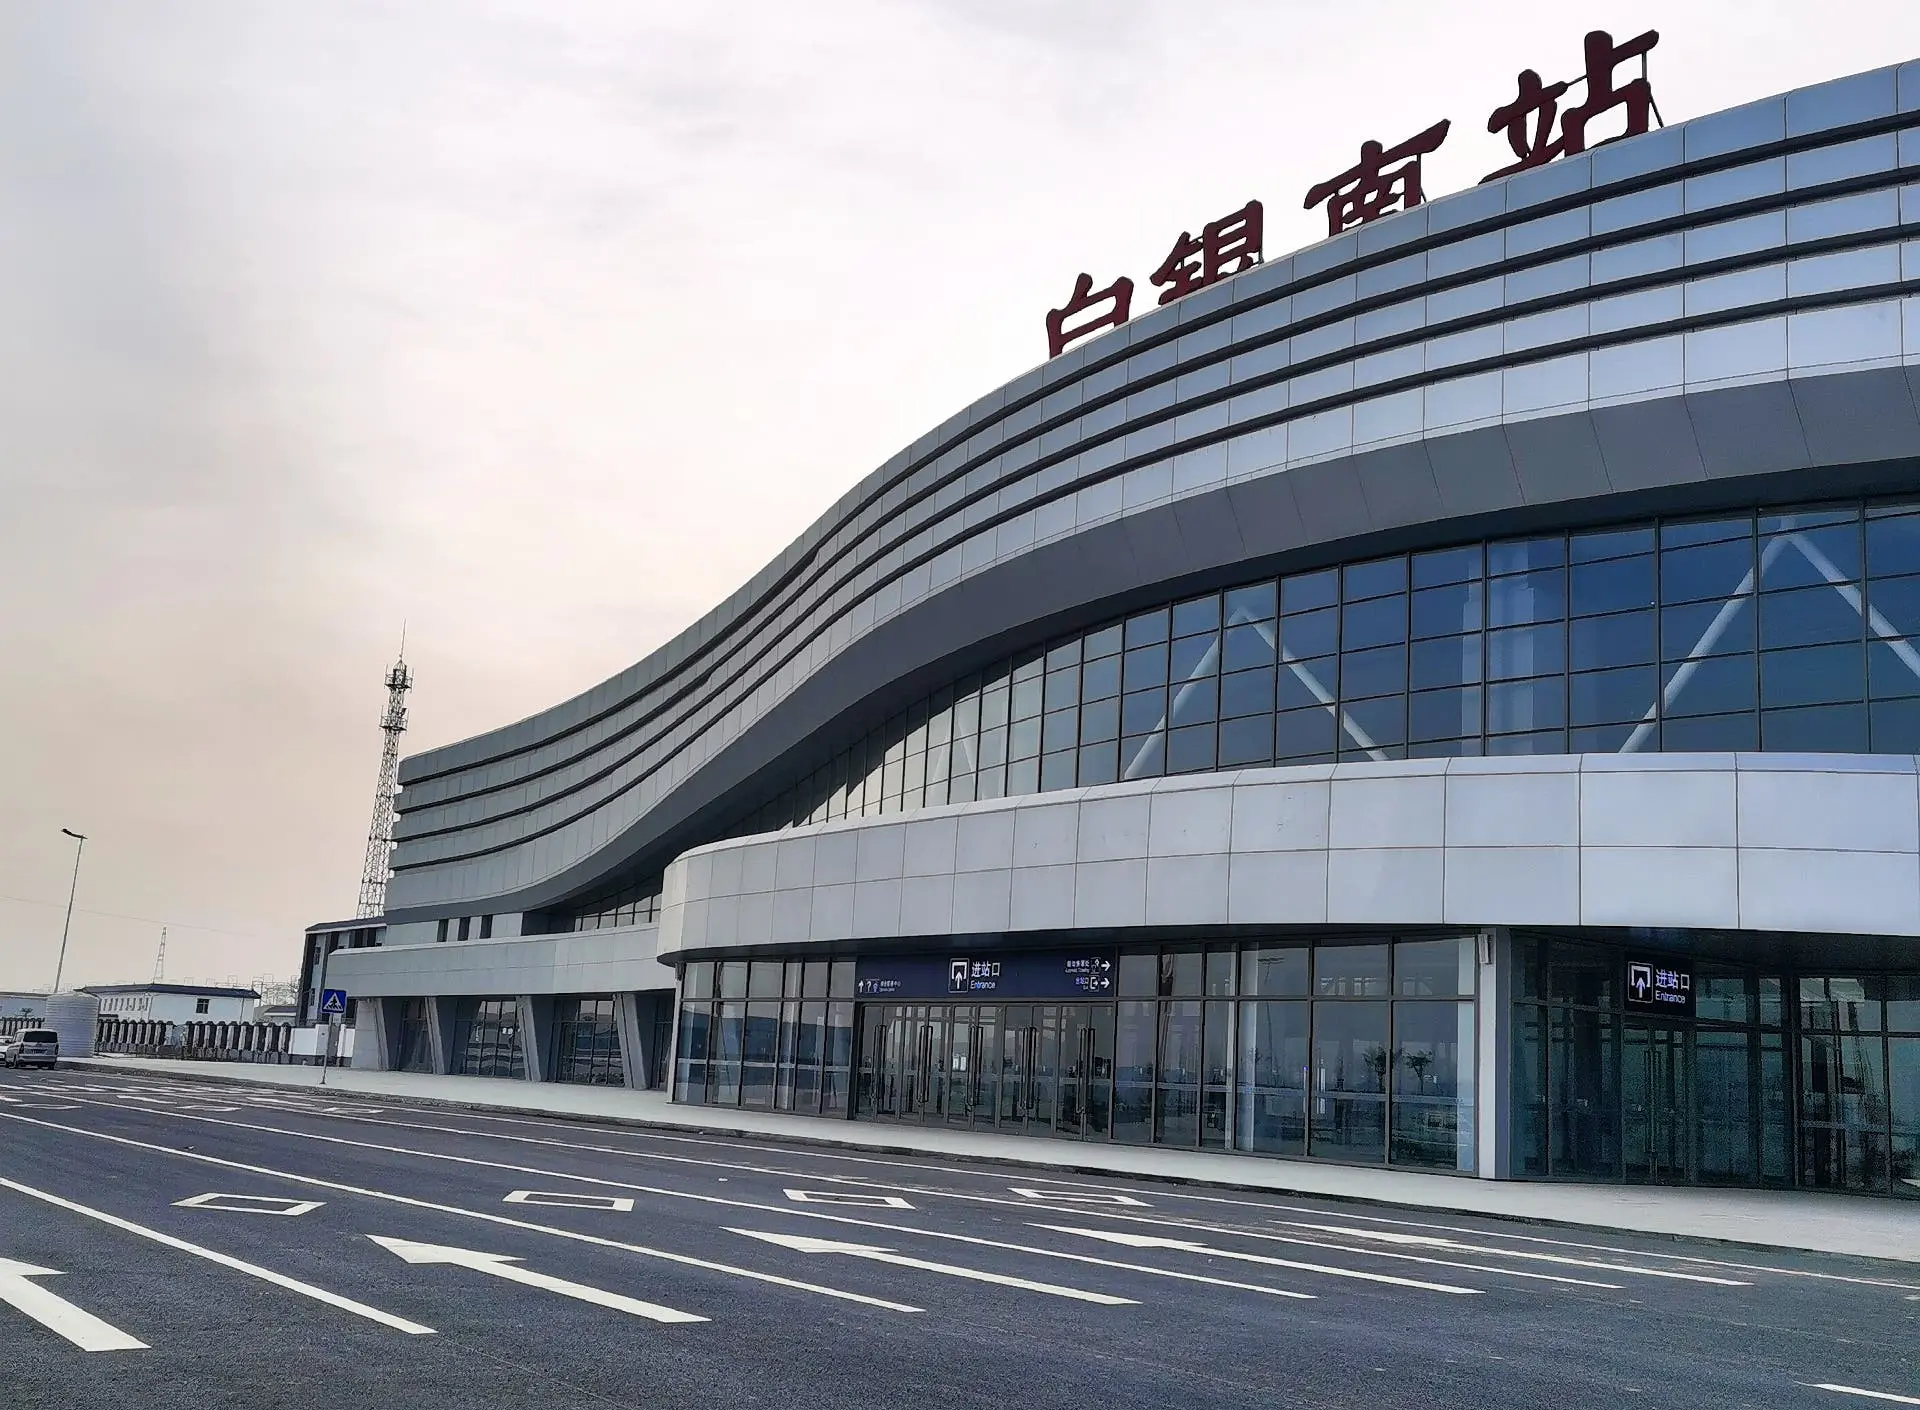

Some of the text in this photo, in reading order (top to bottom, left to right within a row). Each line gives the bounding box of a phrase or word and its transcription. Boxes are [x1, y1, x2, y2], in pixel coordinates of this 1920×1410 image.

[1046, 30, 1659, 358] 白银南站
[971, 960, 1001, 977] 进站口
[970, 980, 996, 989] Entrance
[1655, 969, 1690, 991] 进站口
[1655, 990, 1686, 1004] Entrance
